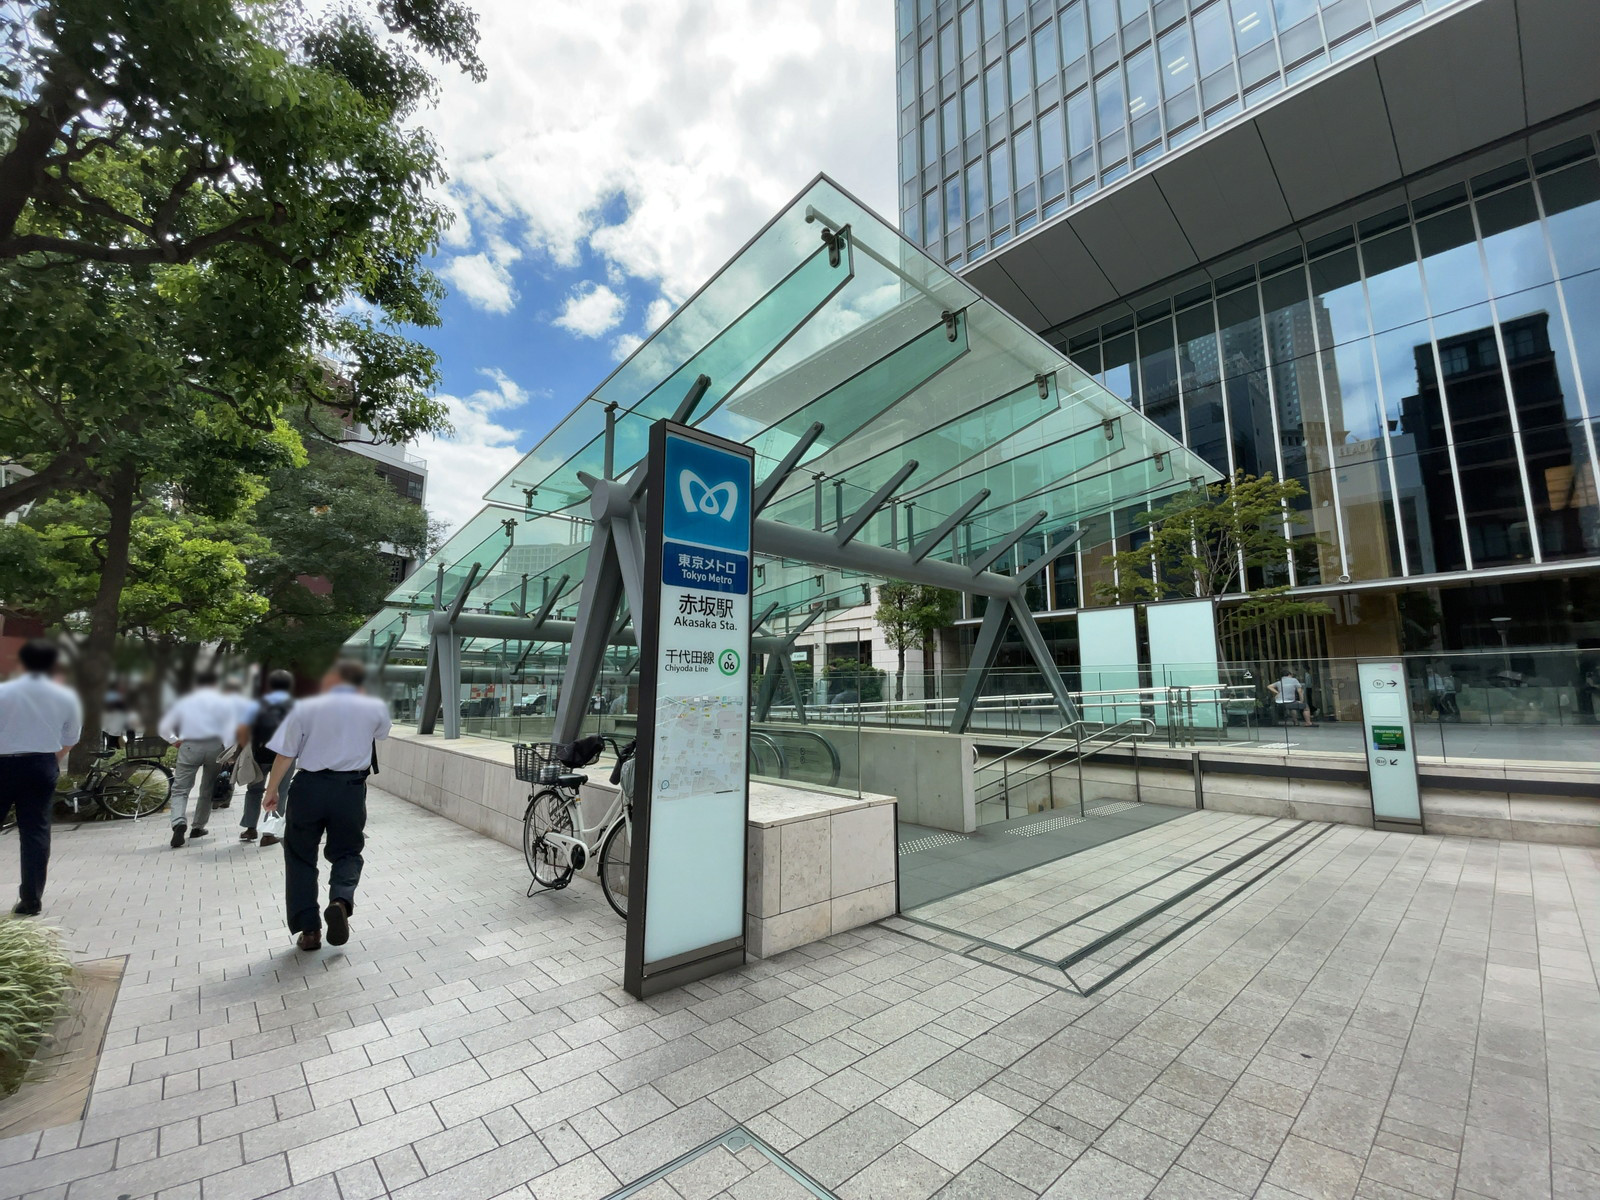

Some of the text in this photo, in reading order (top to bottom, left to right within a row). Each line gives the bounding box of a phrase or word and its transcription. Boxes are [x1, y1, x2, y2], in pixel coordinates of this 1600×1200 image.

[678, 553, 736, 574] 東京メトロ
[681, 569, 733, 585] Tokyo Metro
[679, 594, 734, 618] 赤坂駅
[674, 616, 738, 631] Akasaka Sta.
[665, 649, 715, 665] 千代田線
[664, 664, 709, 674] Chiyoda Line
[723, 661, 735, 670] 06
